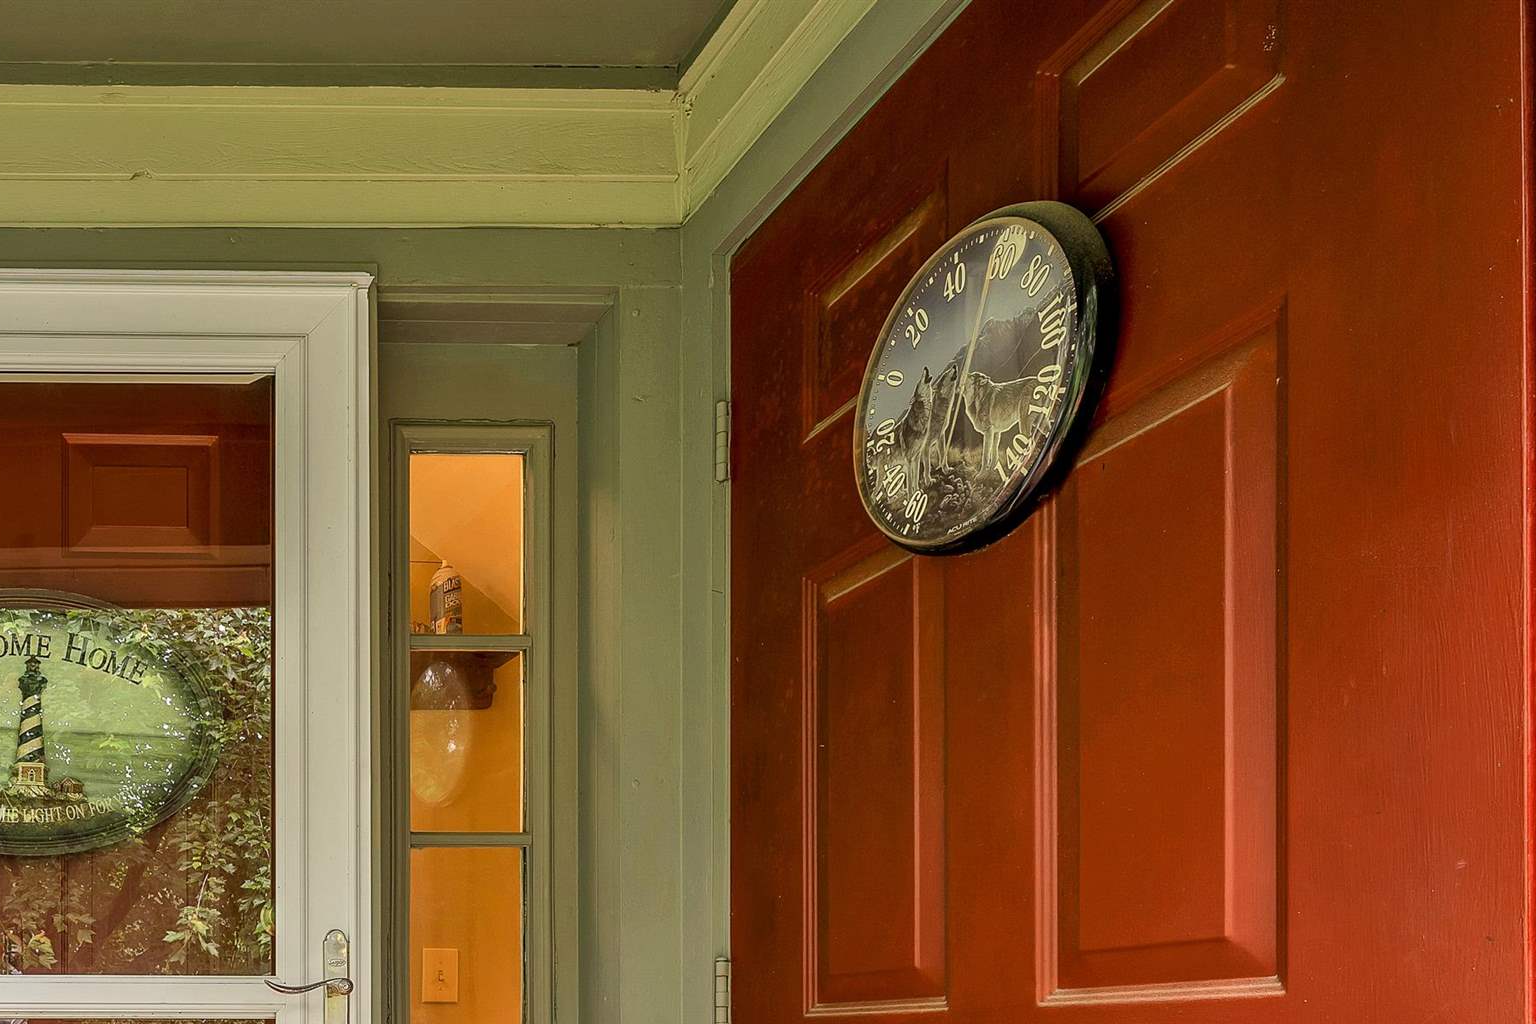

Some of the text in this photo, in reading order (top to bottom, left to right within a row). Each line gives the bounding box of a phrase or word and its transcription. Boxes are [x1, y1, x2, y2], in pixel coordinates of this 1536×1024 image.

[942, 261, 967, 303] 40
[988, 242, 1017, 281] 60
[1020, 254, 1051, 297] 80
[904, 307, 930, 349] 20
[1037, 292, 1068, 350] 100
[885, 370, 905, 388] 0
[1027, 363, 1062, 417] 120
[995, 432, 1031, 487] 140
[61, 632, 147, 684] HOME
[22, 805, 65, 824] LIGHT
[65, 801, 86, 820] ON
[88, 796, 116, 817] FOR
